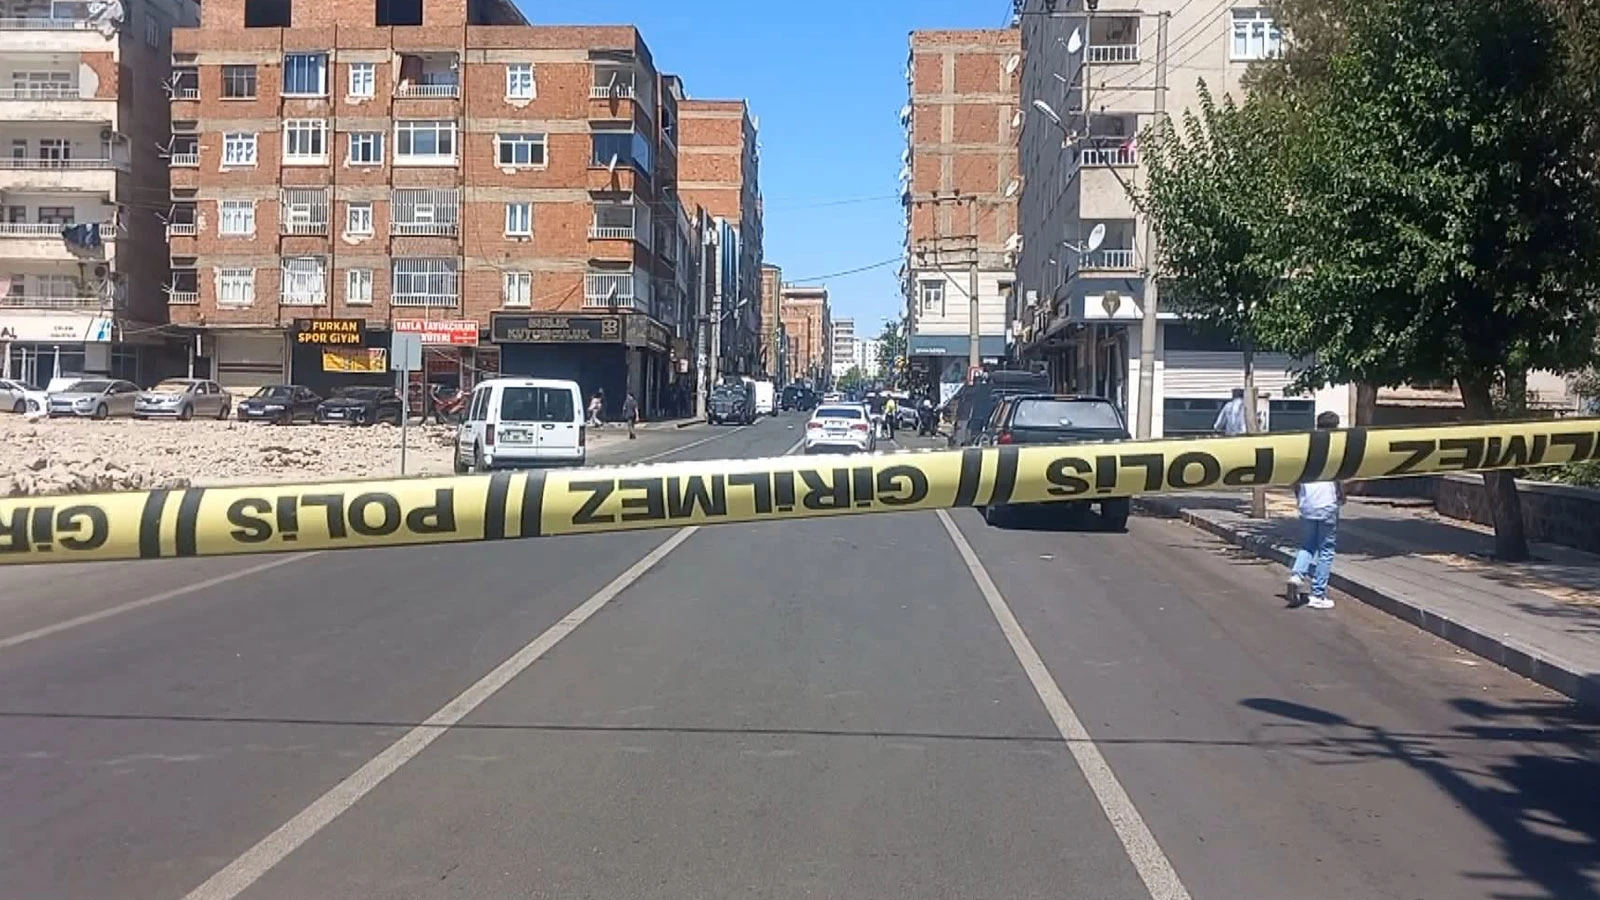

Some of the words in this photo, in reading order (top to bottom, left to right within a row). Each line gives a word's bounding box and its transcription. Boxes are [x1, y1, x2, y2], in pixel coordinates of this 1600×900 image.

[298, 333, 327, 343] SPOR
[329, 333, 360, 343] GİYİM
[312, 321, 357, 332] FURKAN
[1046, 447, 1274, 495] POLİS
[1383, 431, 1600, 475] LMEZ
[227, 488, 457, 543] POLİS
[568, 465, 928, 524] GİRİLMEZ
